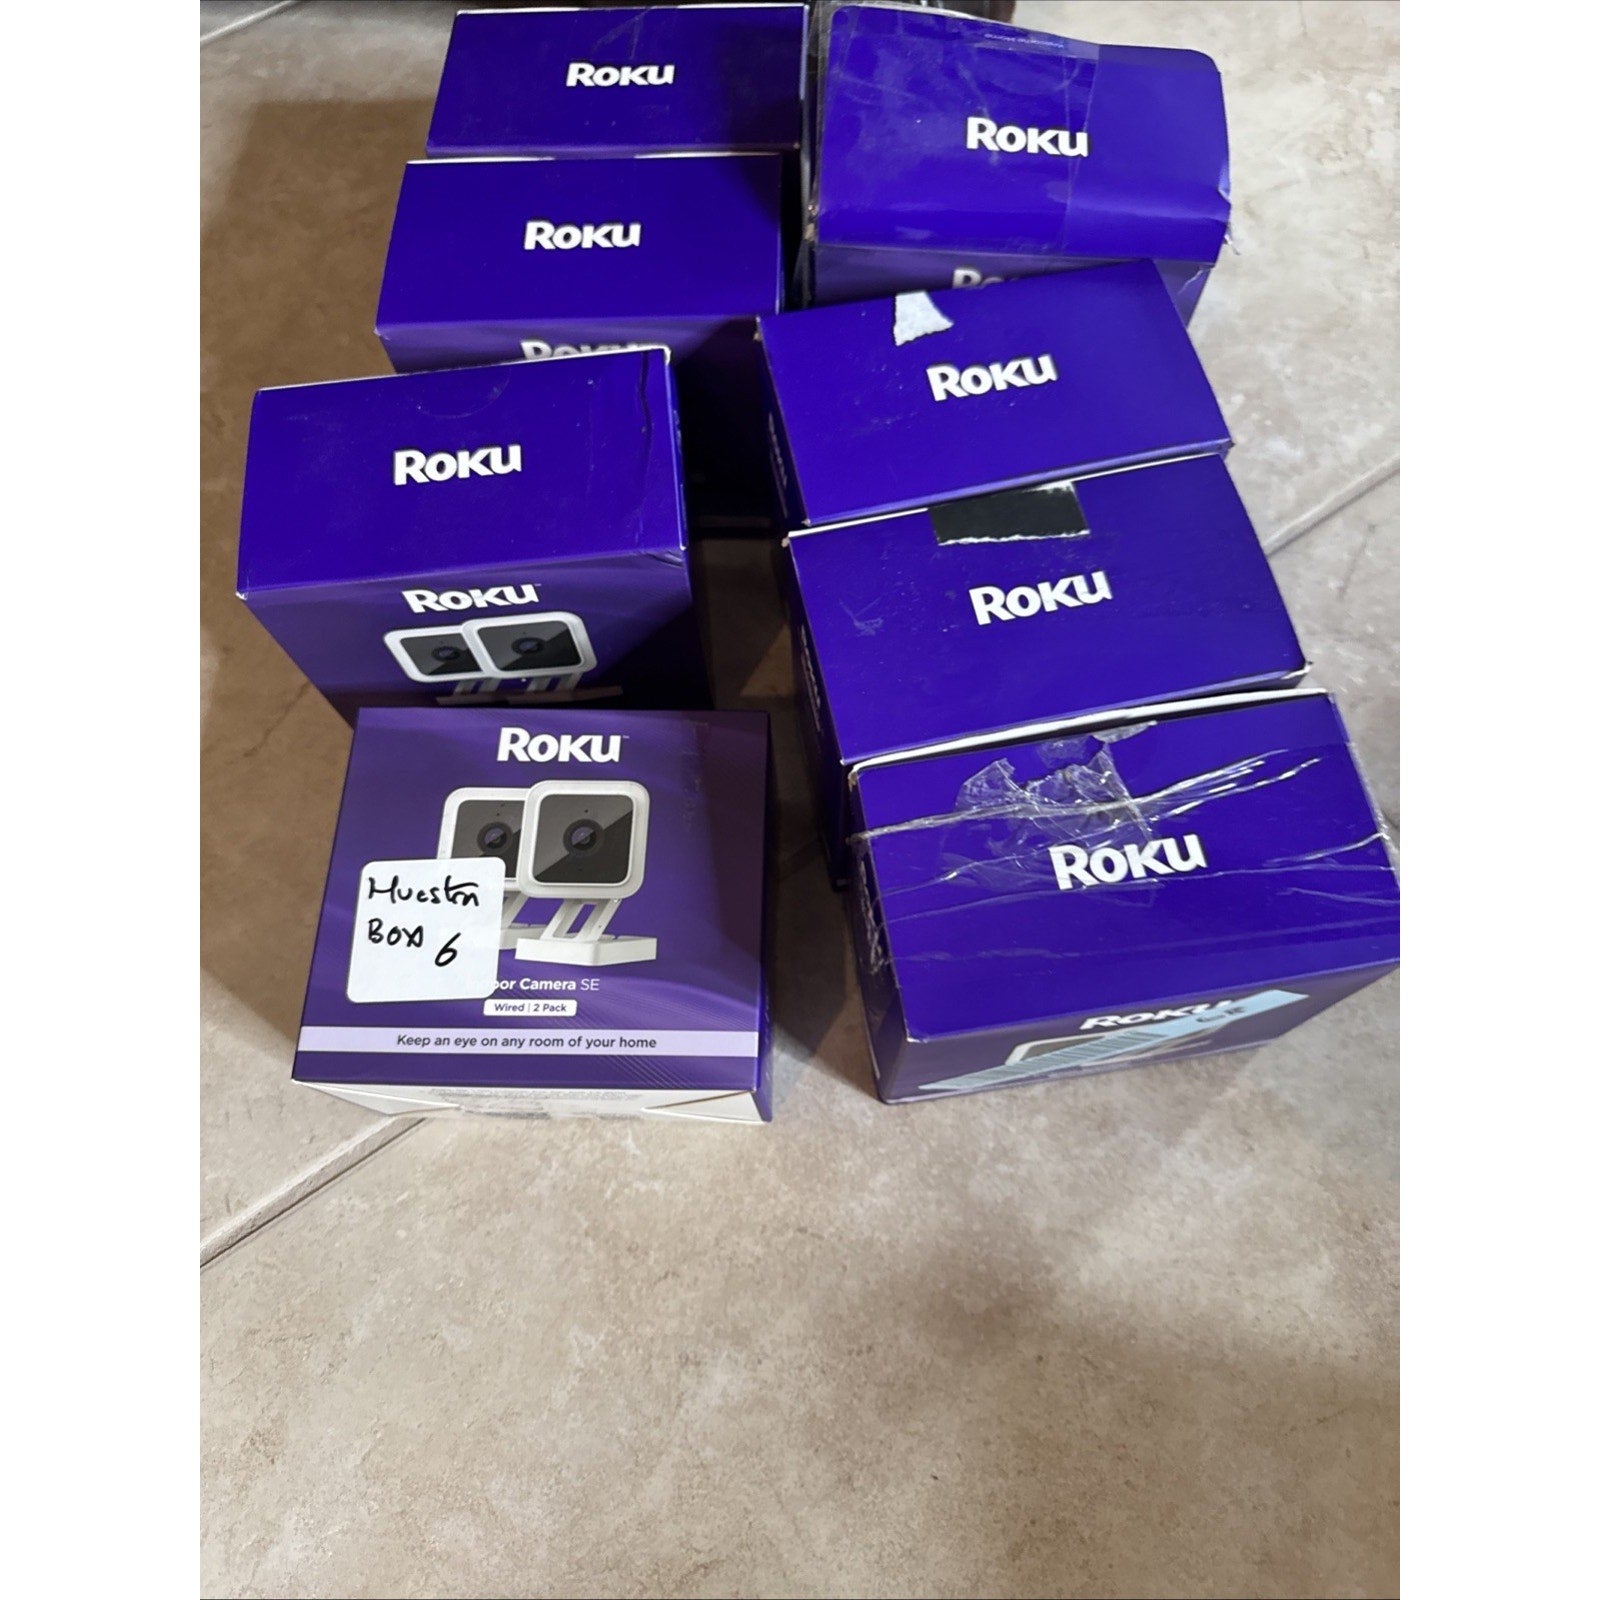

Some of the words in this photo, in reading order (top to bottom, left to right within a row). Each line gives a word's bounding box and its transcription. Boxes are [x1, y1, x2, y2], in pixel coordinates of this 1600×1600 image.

[566, 62, 675, 87] Roku
[966, 116, 1089, 158] Roku
[524, 220, 641, 250] Roku
[926, 355, 1058, 402] Roku
[394, 444, 522, 486] Roku
[402, 584, 540, 613] Roku
[968, 570, 1113, 626] Roku
[496, 726, 622, 763] Roku
[1048, 832, 1207, 891] Roku
[434, 931, 462, 968] 6
[519, 977, 577, 991] Camera
[580, 978, 601, 991] SE
[494, 1003, 526, 1013] Wired
[533, 1003, 541, 1013] 2
[542, 1003, 568, 1013] Pack
[396, 1034, 431, 1048] Keep
[434, 1036, 451, 1047] an
[453, 1036, 478, 1049] eye
[481, 1037, 498, 1047] on
[501, 1037, 526, 1049] any
[528, 1037, 565, 1048] room
[568, 1035, 583, 1048] of
[586, 1038, 616, 1050] your
[618, 1036, 658, 1049] home
